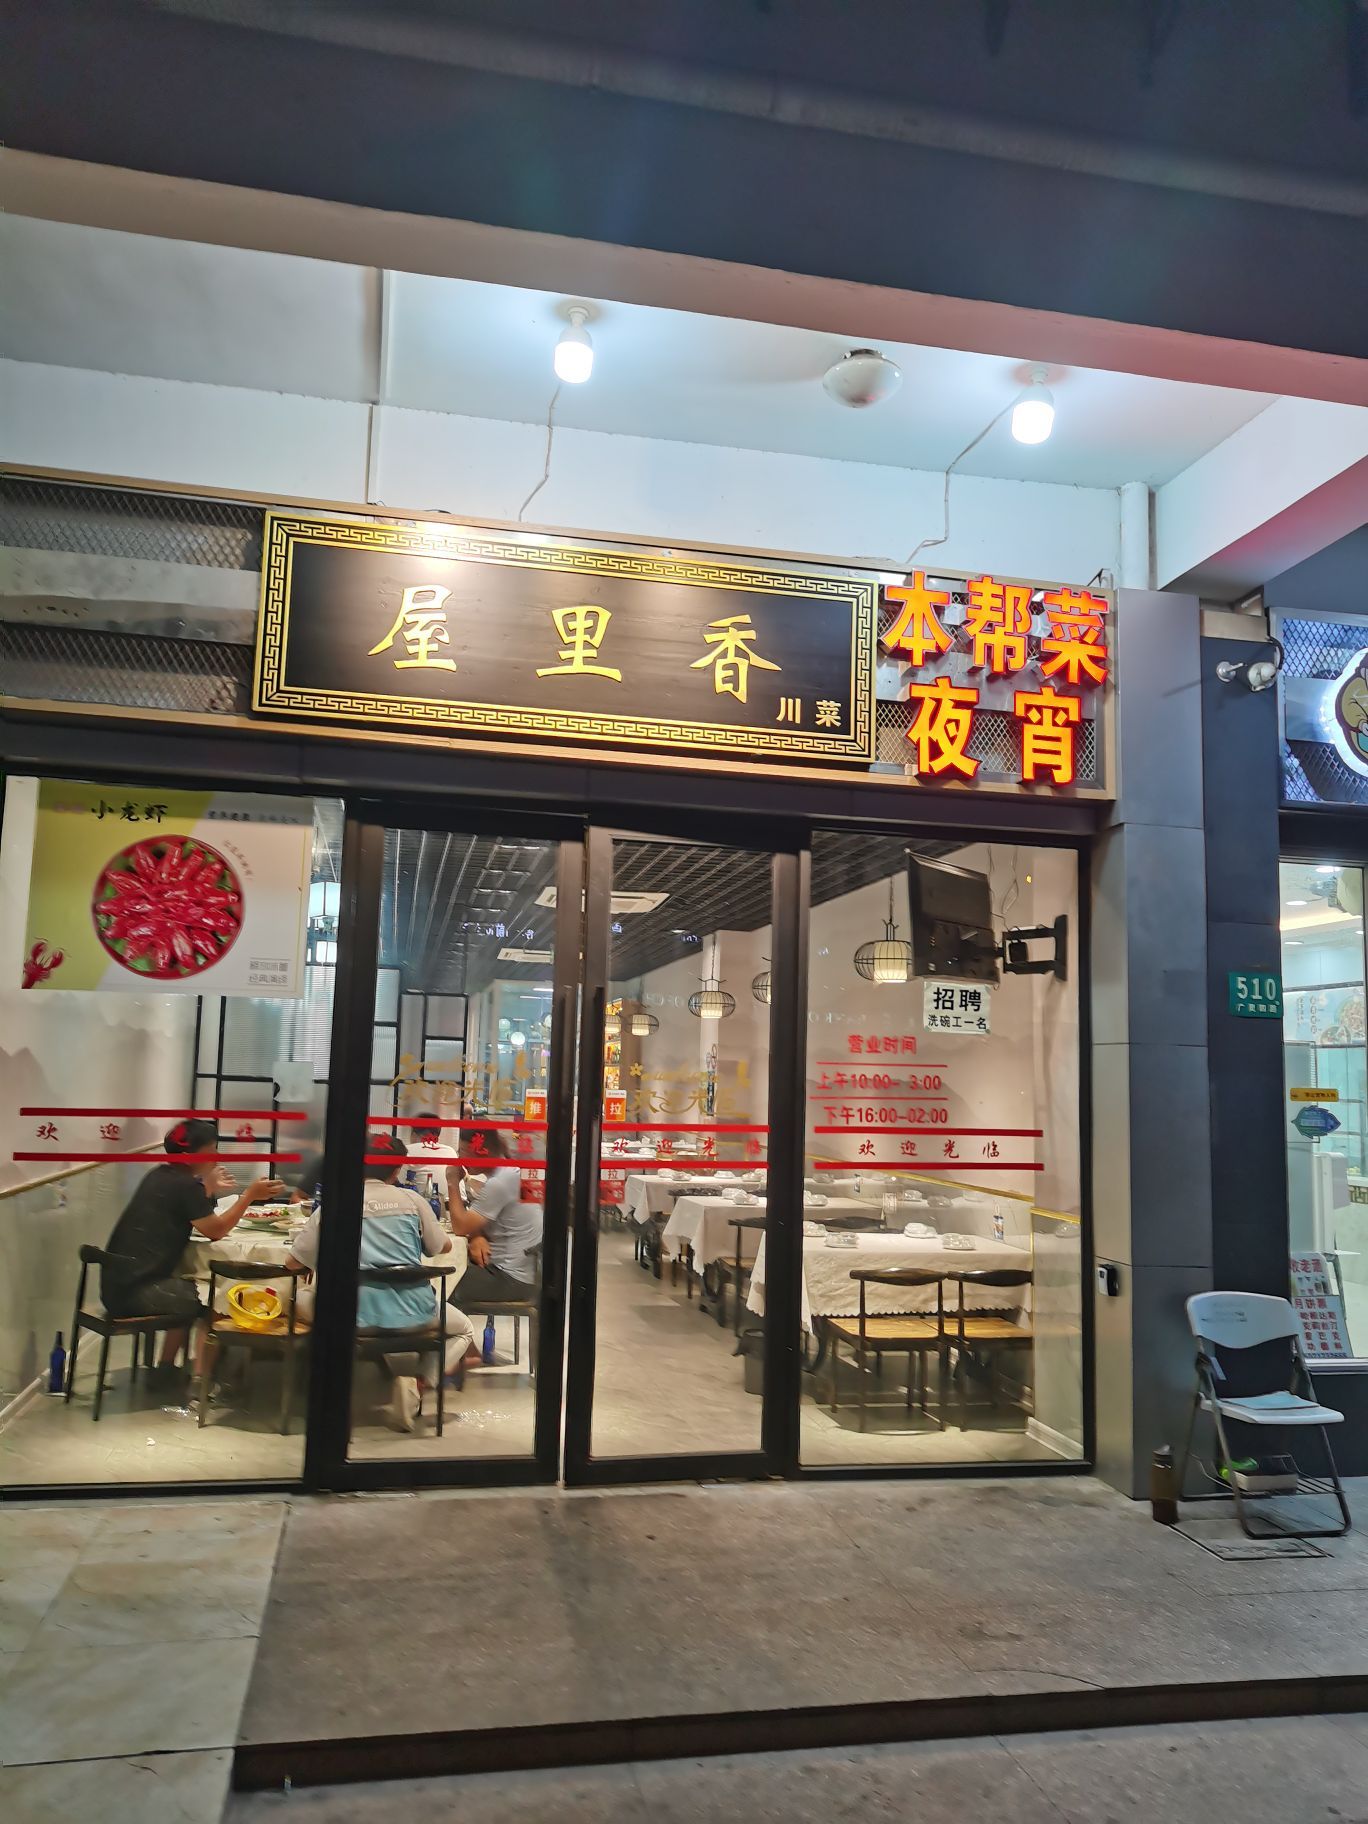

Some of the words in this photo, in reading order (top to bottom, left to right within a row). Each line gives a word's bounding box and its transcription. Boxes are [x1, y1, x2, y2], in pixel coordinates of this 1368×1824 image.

[879, 570, 1109, 685] 本帮菜
[368, 584, 782, 703] 屋里香
[776, 696, 843, 728] 川菜
[906, 676, 1082, 784] 夜宵
[91, 800, 168, 823] 小龙虾
[933, 987, 982, 1012] 招聘
[1236, 976, 1277, 1000] 510
[928, 1014, 988, 1030] 洗碗工一名
[848, 1034, 918, 1055] 营业时间
[609, 1102, 622, 1116] 拉
[858, 1139, 1001, 1159] 欢迎光临
